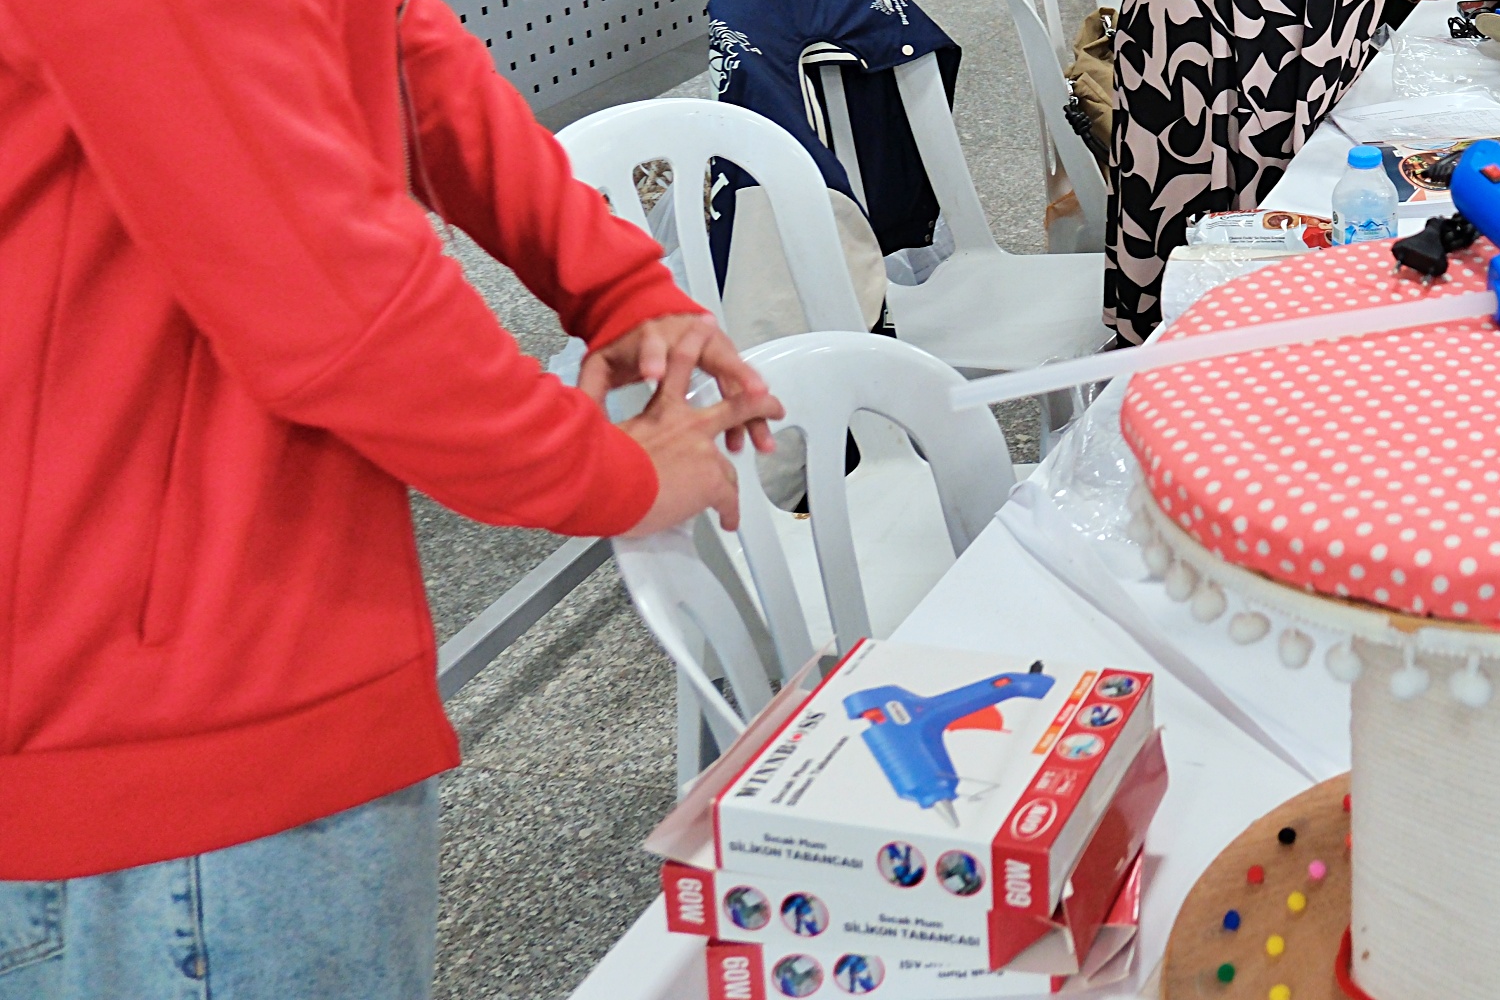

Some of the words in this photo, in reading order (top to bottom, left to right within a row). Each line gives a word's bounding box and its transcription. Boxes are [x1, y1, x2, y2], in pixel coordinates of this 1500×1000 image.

[675, 877, 706, 924] 60W
[1005, 859, 1032, 908] 60W
[722, 956, 752, 999] 60W
